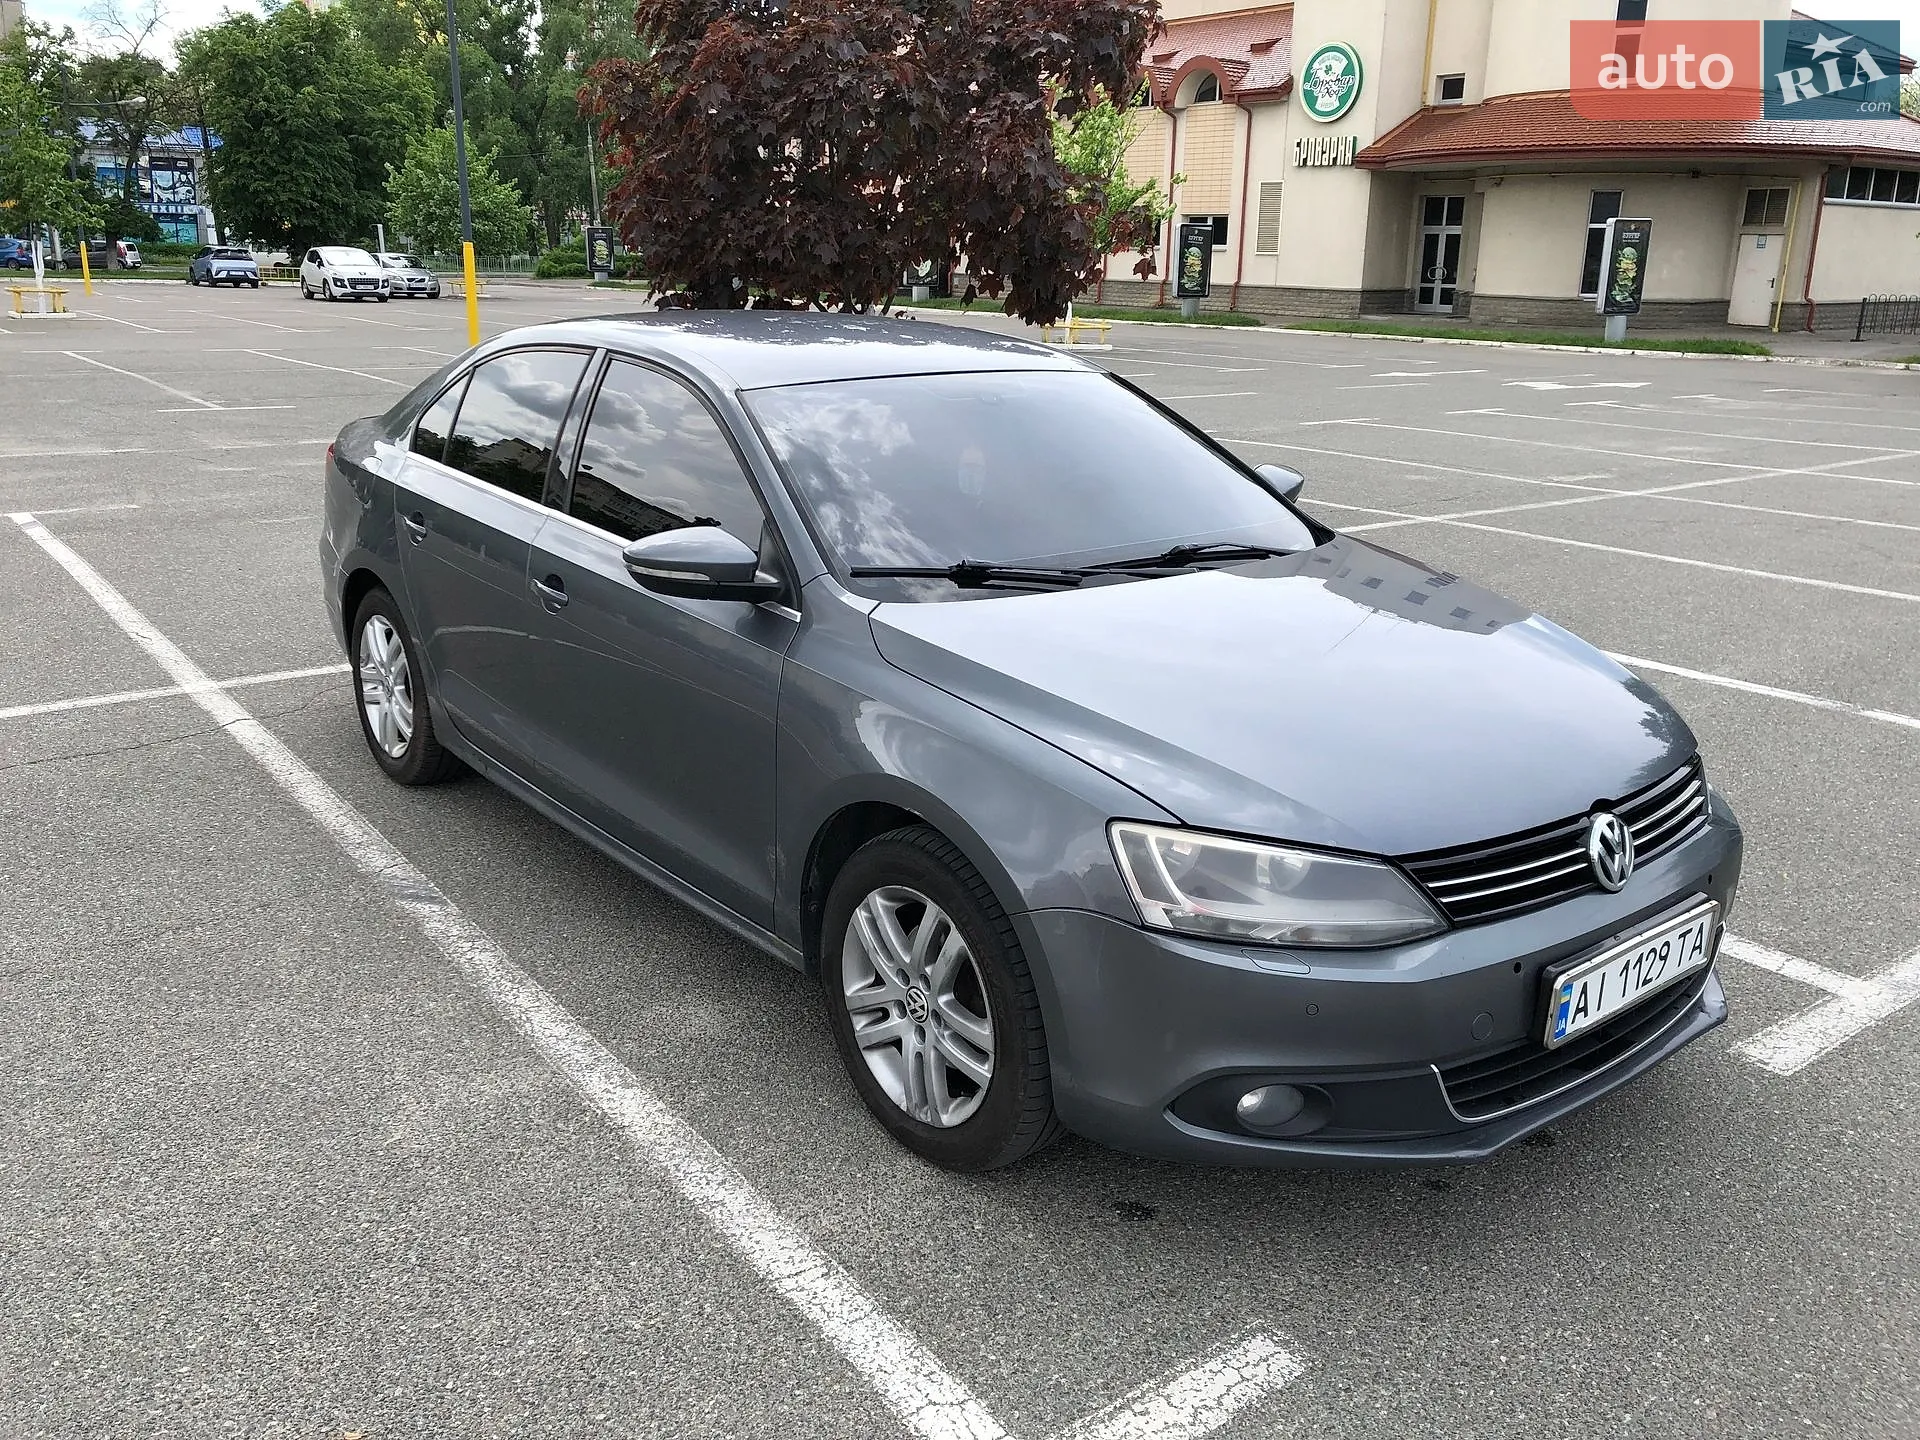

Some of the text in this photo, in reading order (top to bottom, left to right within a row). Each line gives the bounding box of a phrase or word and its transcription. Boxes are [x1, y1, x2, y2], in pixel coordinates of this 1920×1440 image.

[1571, 922, 1704, 1025] AI 1129 TA
